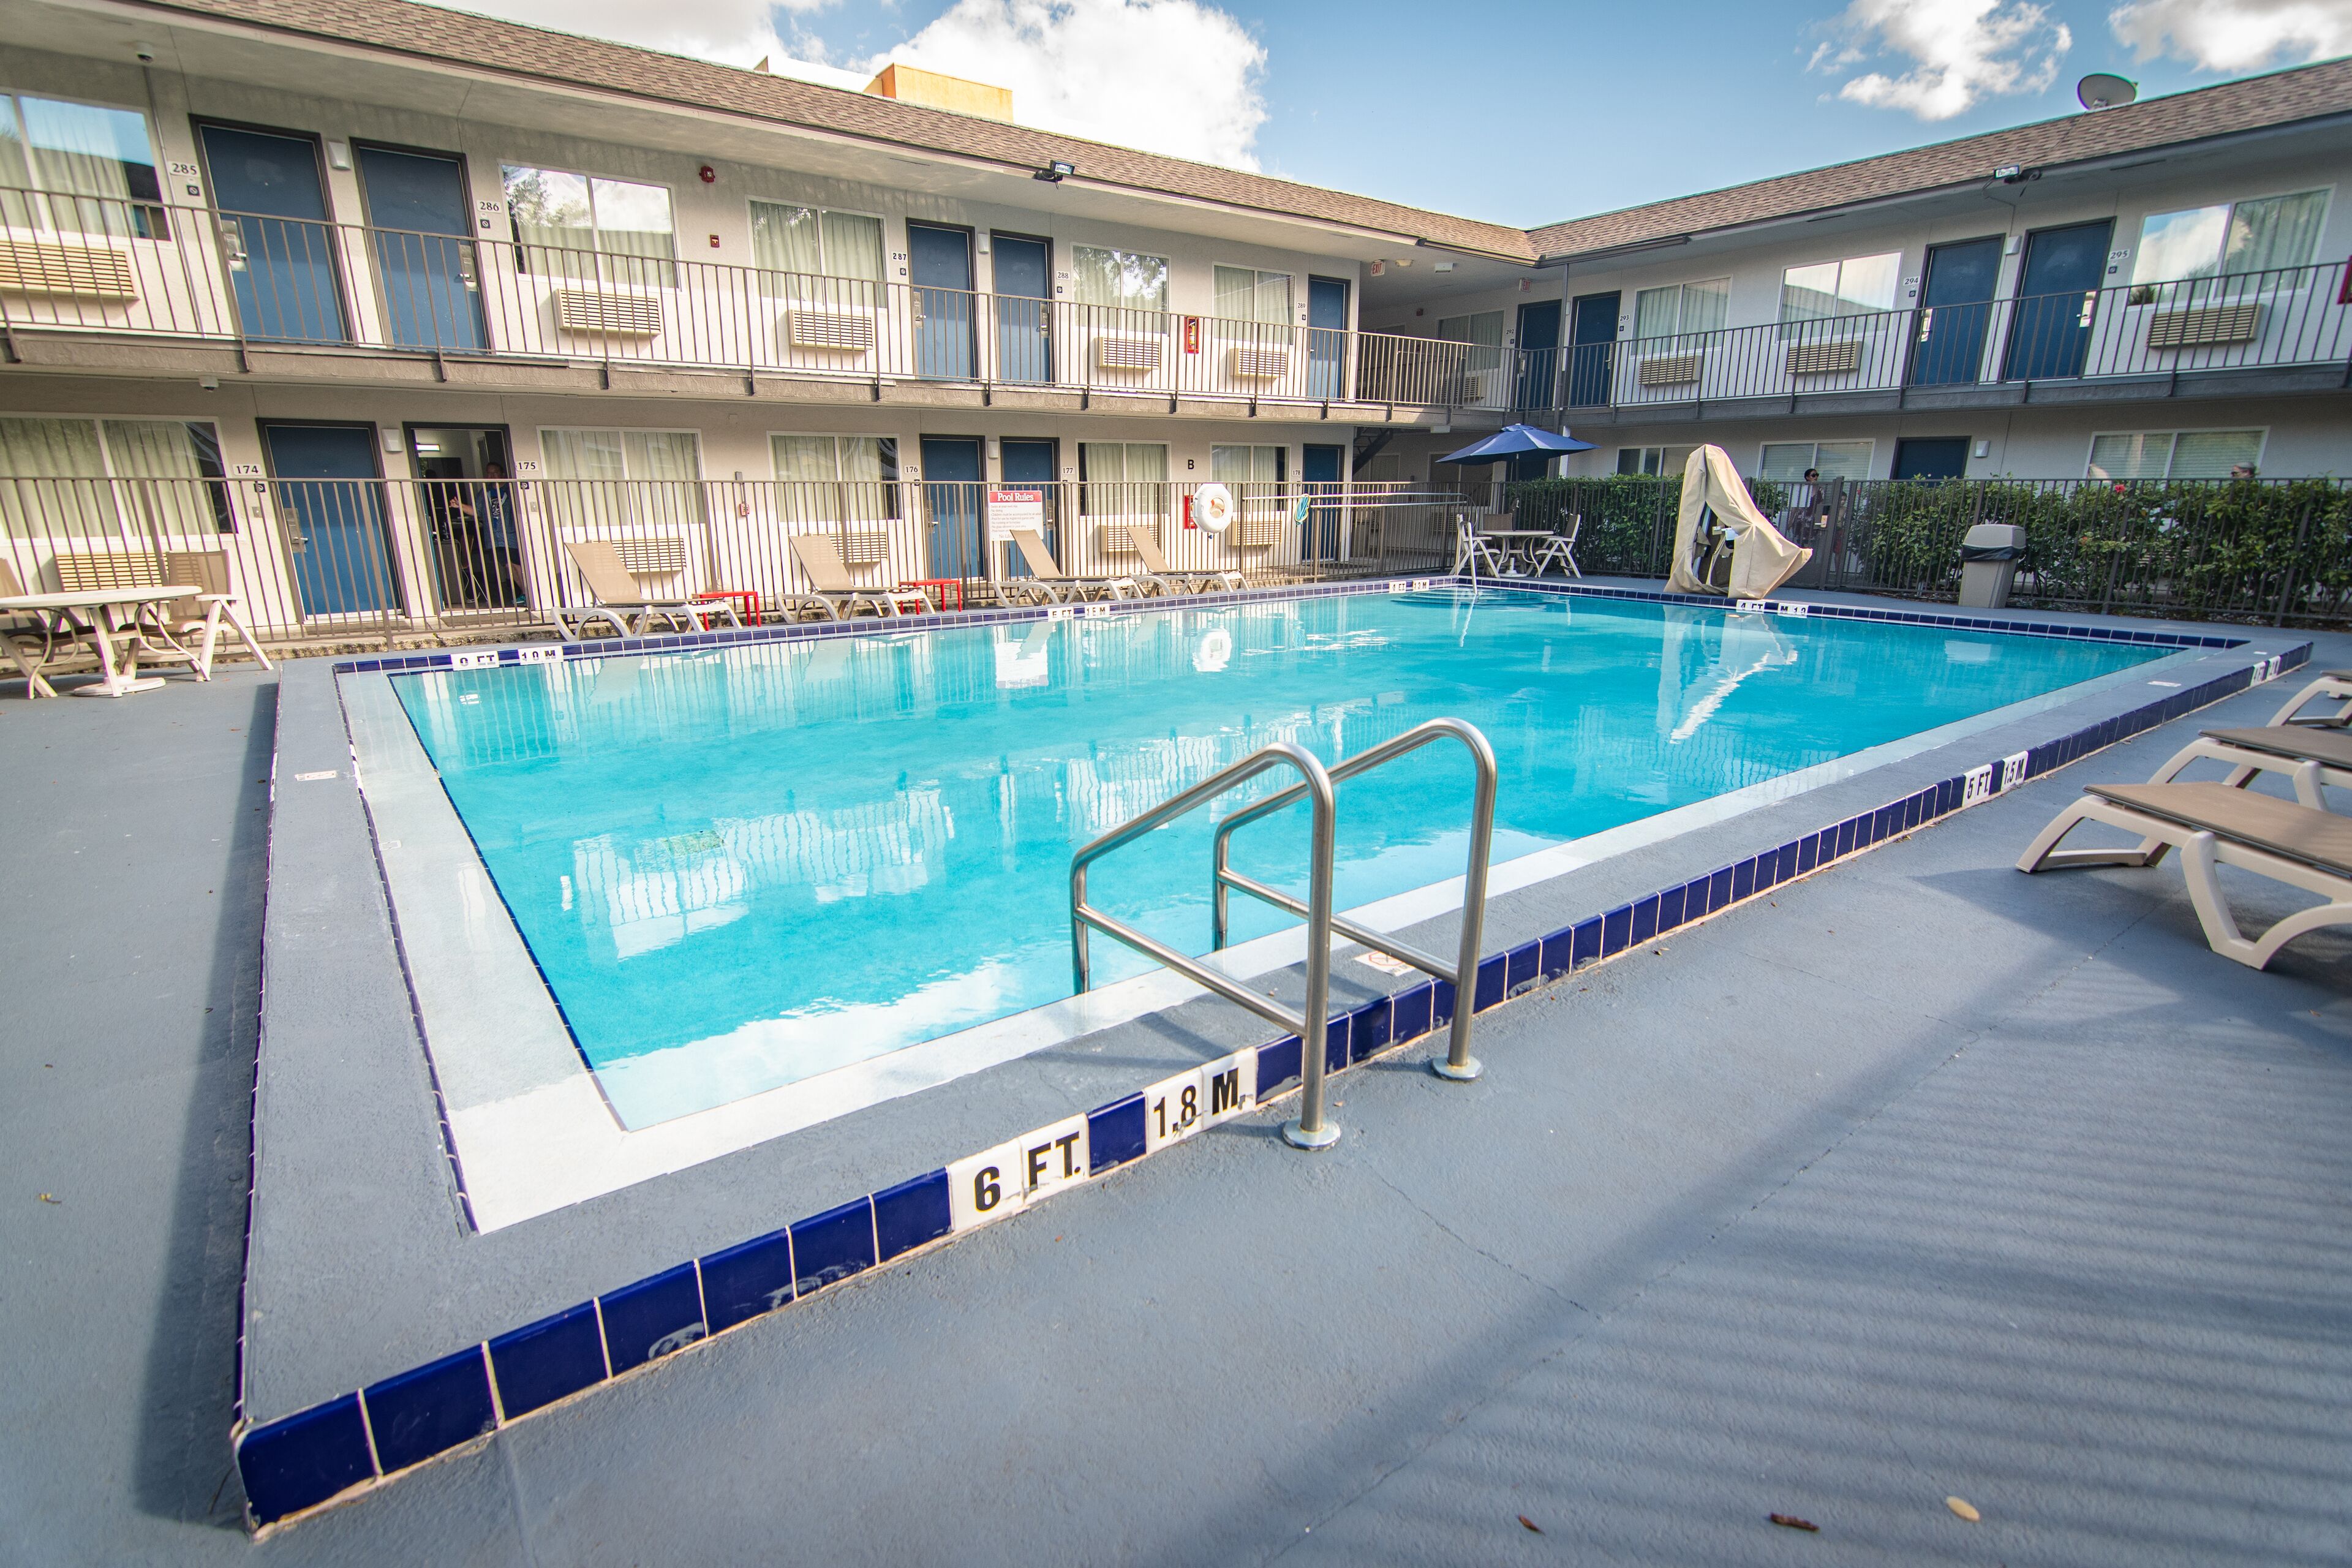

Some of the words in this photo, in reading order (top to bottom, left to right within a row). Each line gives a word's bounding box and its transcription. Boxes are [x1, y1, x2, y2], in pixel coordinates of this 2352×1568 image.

[172, 163, 197, 175] 285
[480, 202, 499, 211] 286
[892, 252, 907, 261] 287
[2110, 251, 2128, 260] 295
[1372, 263, 1382, 274] EXIT
[236, 465, 259, 474] 174
[1188, 459, 1194, 470] B
[997, 492, 1014, 502] Pool
[1014, 492, 1035, 501] Rules
[2004, 761, 2016, 785] 1.5
[1967, 777, 1975, 799] 5
[1153, 1085, 1197, 1139] 1.8
[974, 1166, 1001, 1212] 6
[1028, 1131, 1081, 1191] FT.
